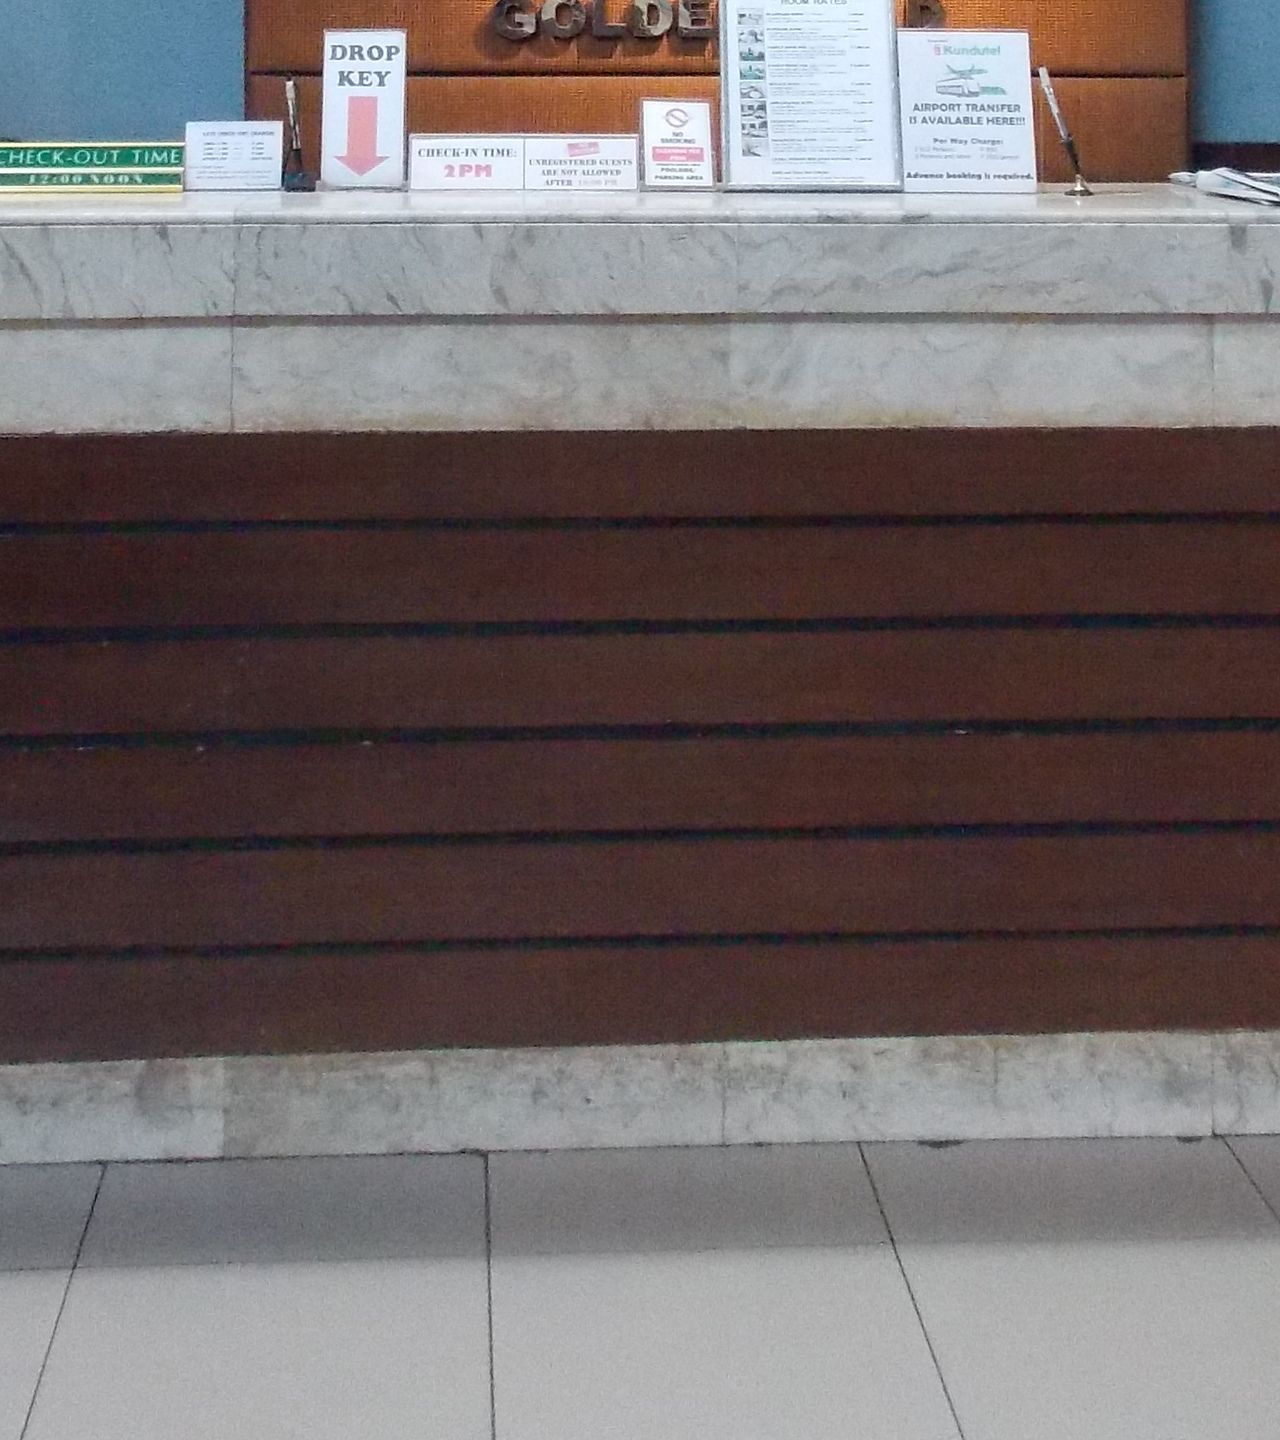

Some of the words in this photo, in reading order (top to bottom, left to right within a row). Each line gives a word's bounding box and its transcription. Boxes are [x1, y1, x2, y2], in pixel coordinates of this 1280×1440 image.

[329, 44, 401, 61] DROP
[337, 70, 392, 87] KEY
[912, 103, 961, 113] AIRPORT
[966, 103, 1021, 113] TRANSFER
[909, 116, 918, 125] IS
[921, 116, 983, 125] AVAILABLE
[986, 116, 1026, 126] HERE!!!
[132, 148, 181, 164] TIME
[418, 147, 479, 158] CHECK-IN
[483, 147, 517, 158] TIME:
[599, 159, 633, 167] GUESTS
[541, 169, 558, 177] ARE
[560, 169, 578, 177] NOT
[581, 169, 621, 177] ALLOWED
[906, 171, 945, 179] Advance
[946, 171, 982, 181] booking
[29, 174, 83, 184] 12:00
[90, 173, 144, 184] NOON
[545, 178, 573, 186] AFTER
